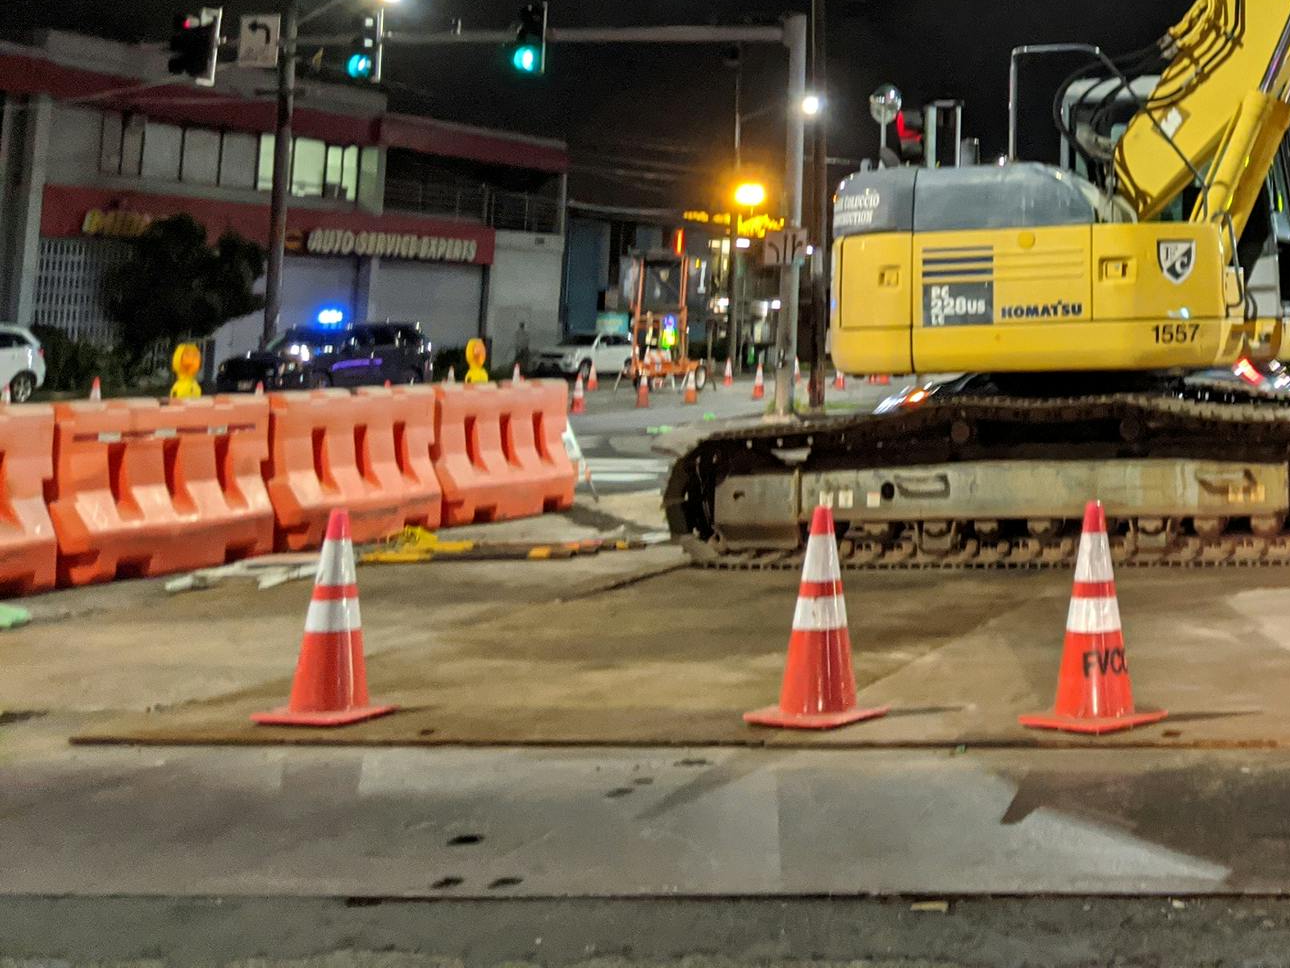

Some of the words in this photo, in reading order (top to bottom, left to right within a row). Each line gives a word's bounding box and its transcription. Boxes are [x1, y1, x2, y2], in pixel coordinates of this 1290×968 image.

[306, 229, 354, 256] AUTO
[354, 231, 419, 259] SERVICE
[418, 236, 478, 263] EXPERTS
[930, 285, 950, 300] PC
[1000, 300, 1083, 319] KOMATSU
[1152, 323, 1201, 345] 1557
